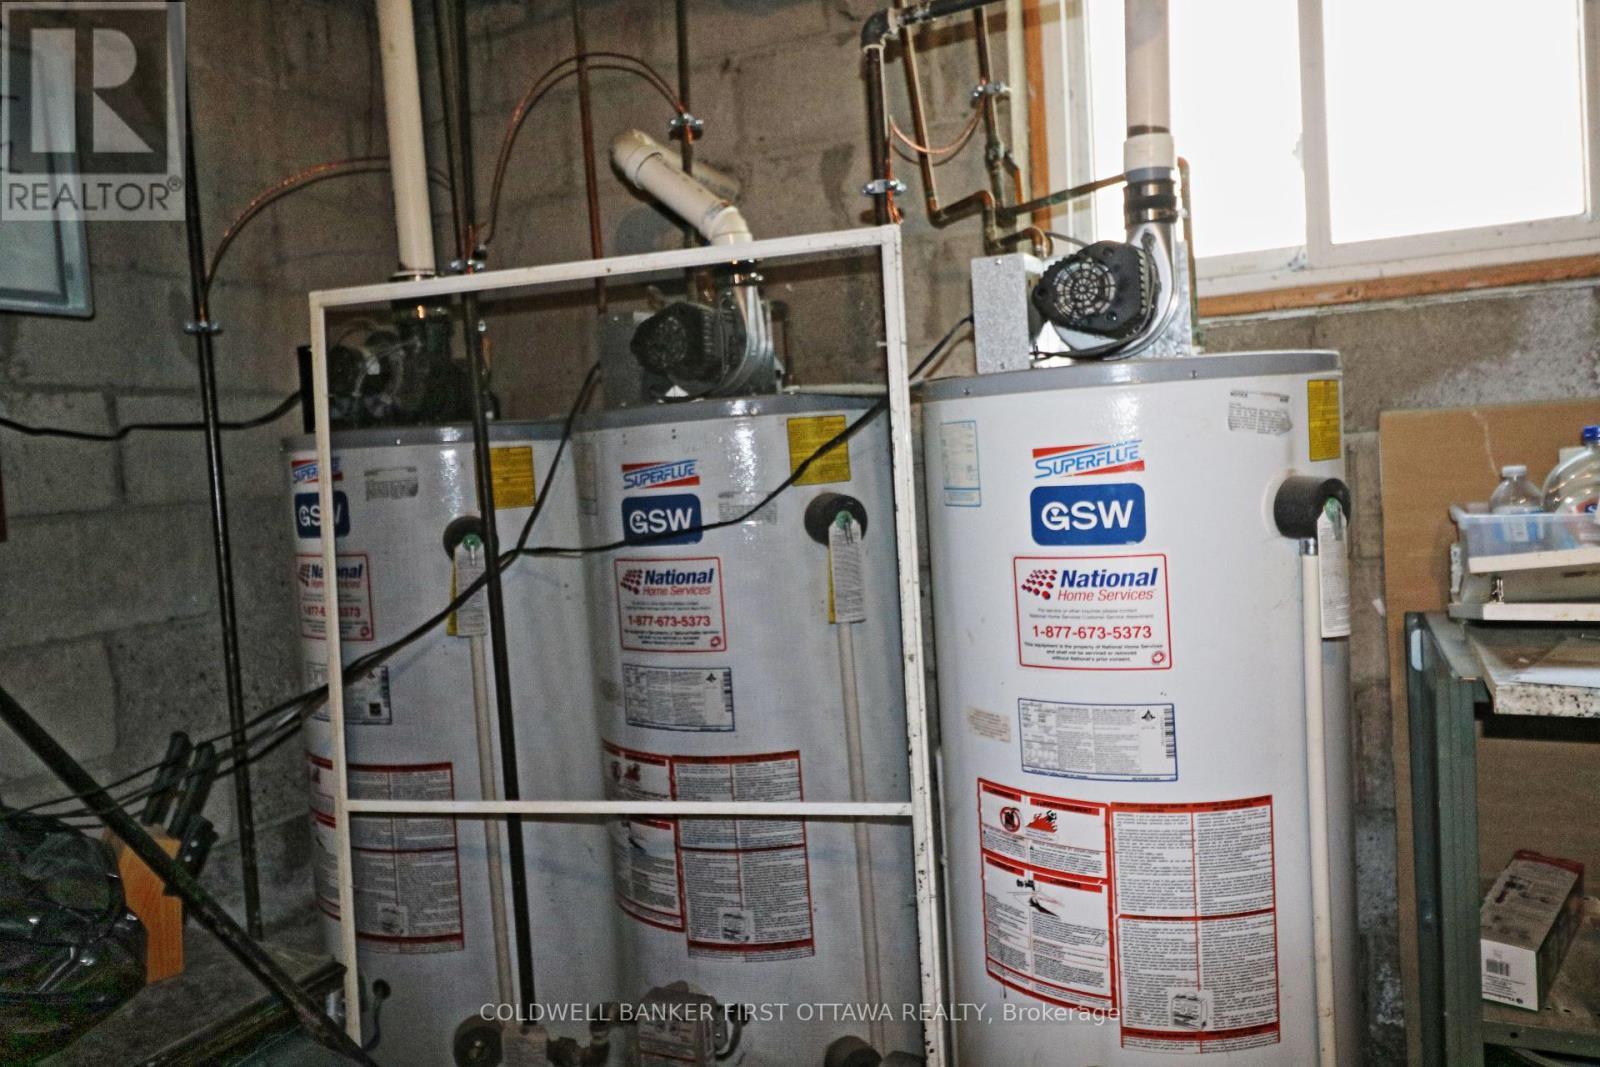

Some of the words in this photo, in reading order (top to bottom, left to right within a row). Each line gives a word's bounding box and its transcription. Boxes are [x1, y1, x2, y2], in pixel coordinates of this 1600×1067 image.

[1034, 439, 1143, 479] SUPERFLUE
[623, 459, 698, 490] SUPERFLUE
[629, 507, 693, 534] GSW
[1041, 499, 1134, 531] GSW
[644, 567, 715, 586] National
[1060, 567, 1159, 588] National
[1057, 590, 1095, 602] Home
[1097, 588, 1154, 602] Services
[1033, 625, 1152, 639] 1-877-673-5373
